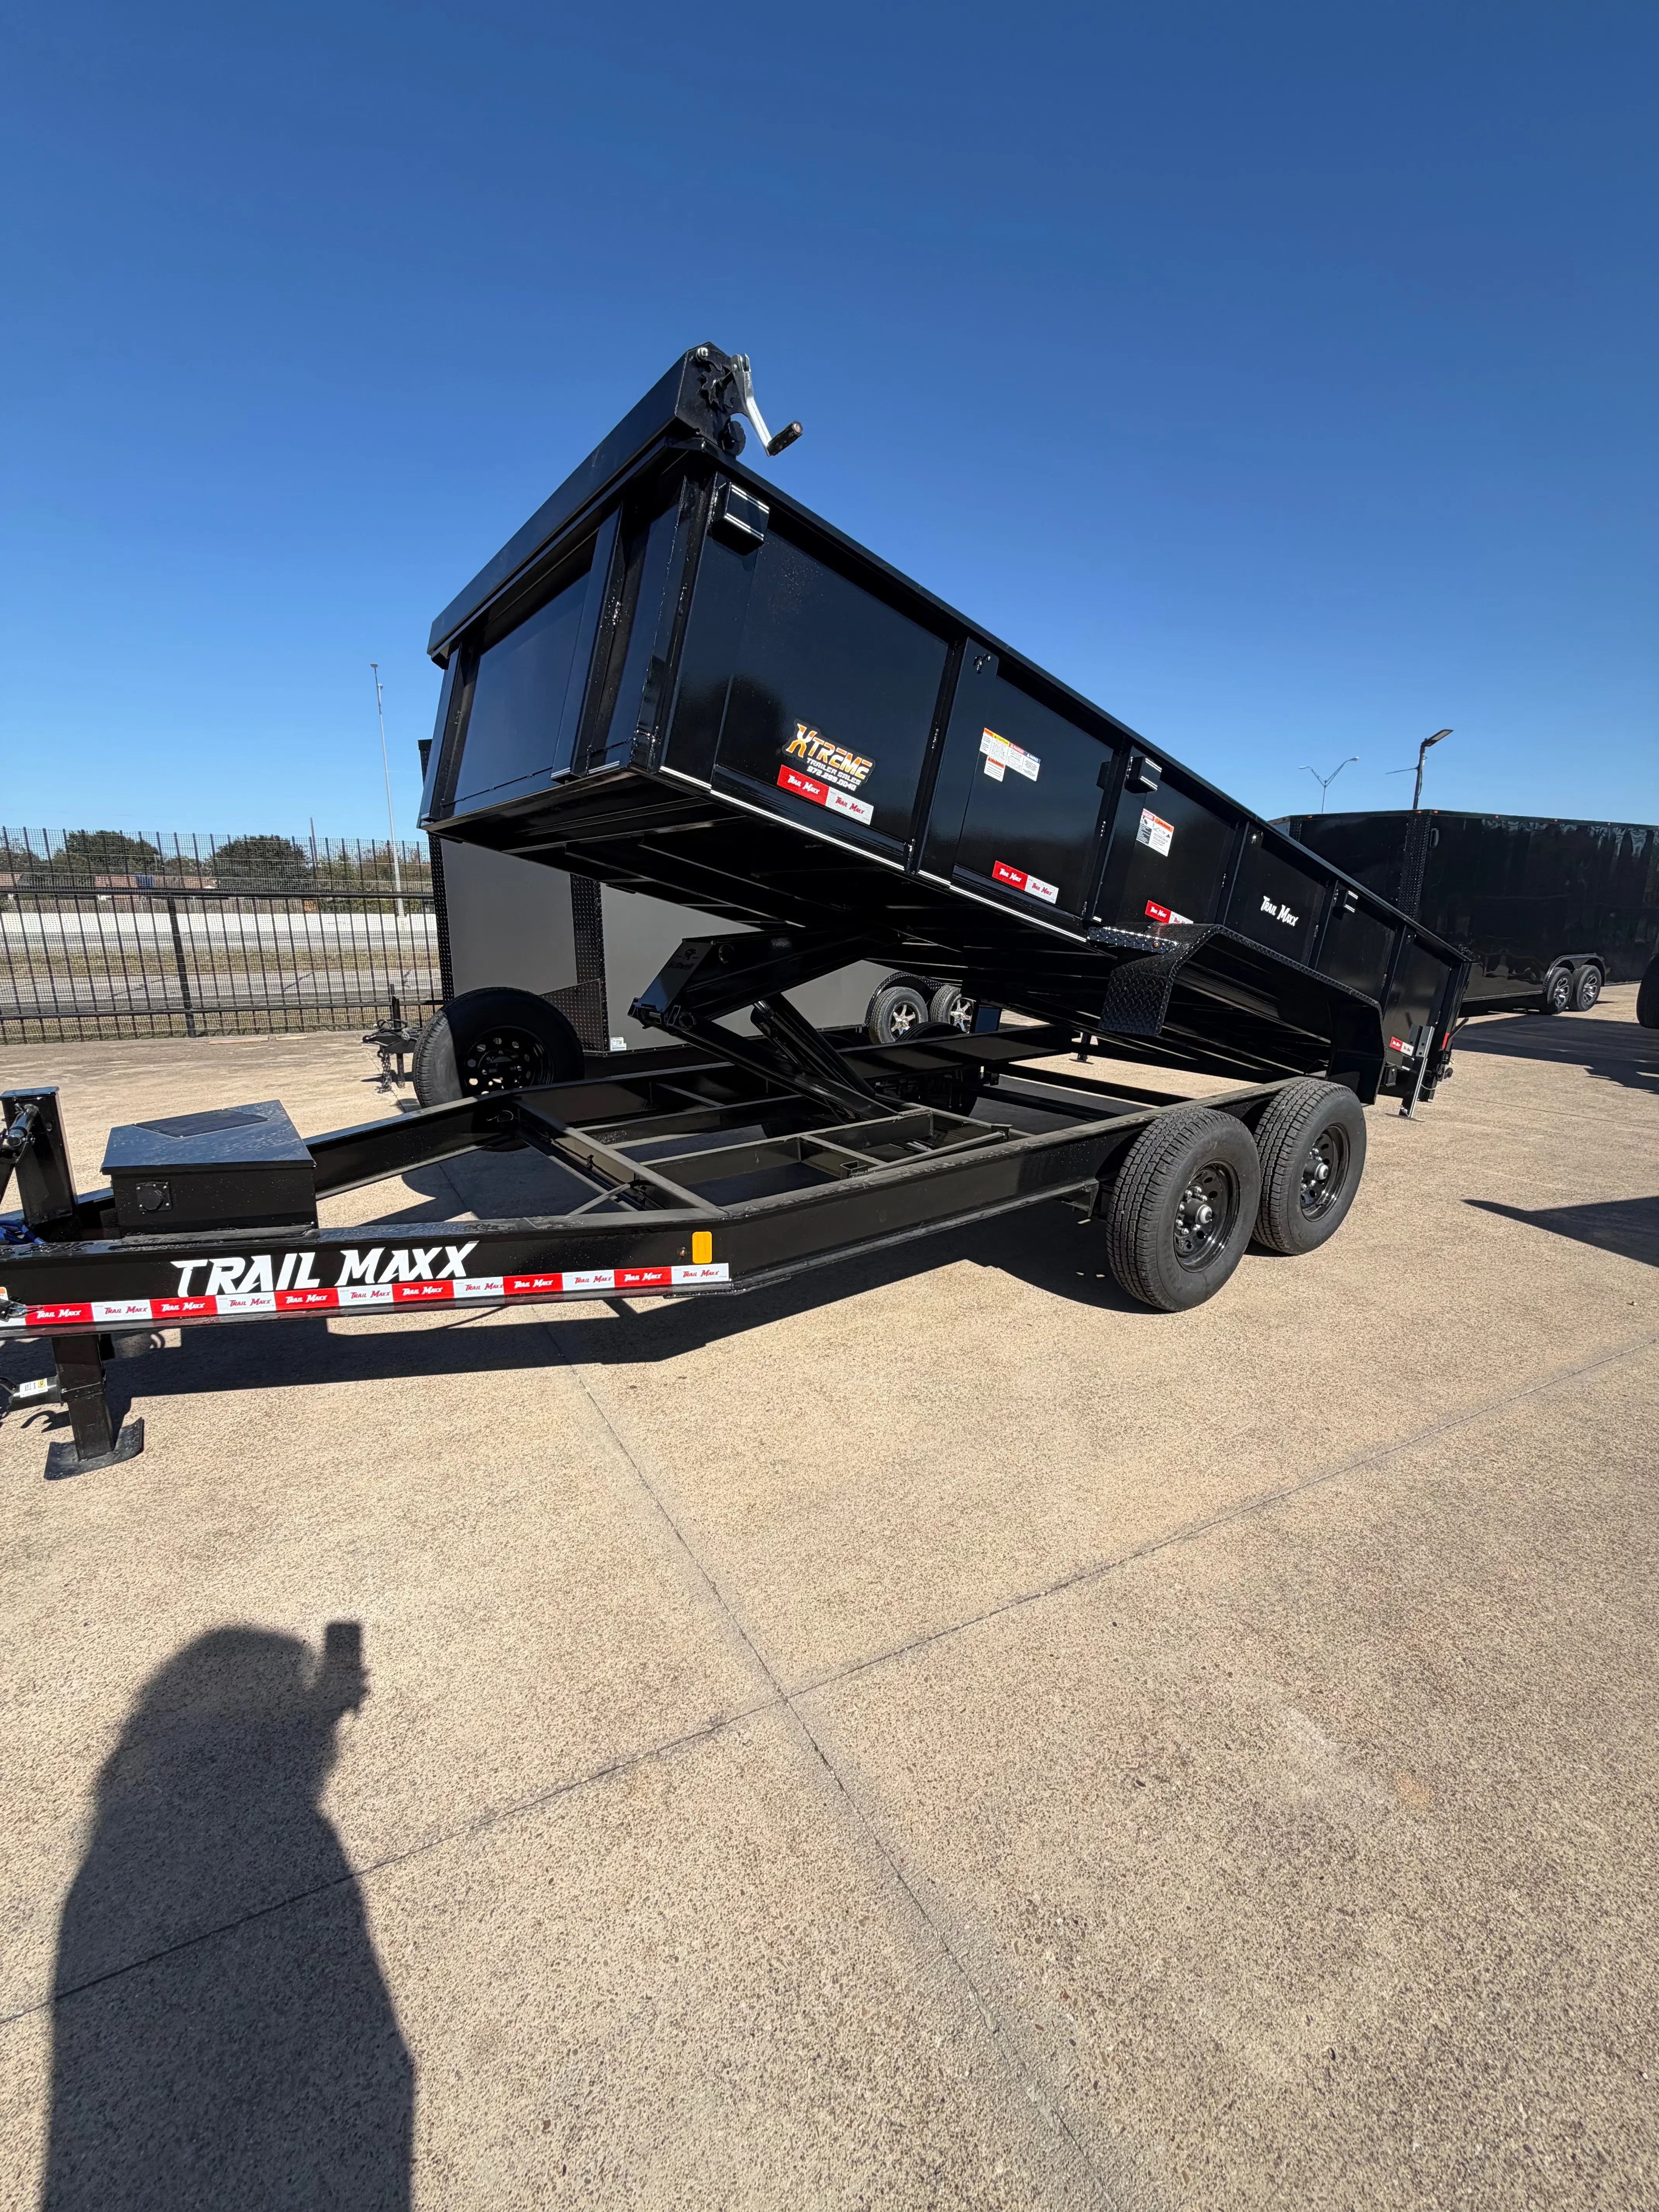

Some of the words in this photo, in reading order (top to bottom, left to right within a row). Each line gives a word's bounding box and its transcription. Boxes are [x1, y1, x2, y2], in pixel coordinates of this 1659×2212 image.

[786, 723, 873, 780] XTREME
[807, 757, 837, 775] TRAILER
[838, 771, 862, 786] SALES
[1261, 895, 1277, 915] TRAIL
[1276, 904, 1299, 926] MAXX
[170, 1252, 320, 1298] TRAIL
[334, 1240, 480, 1286] MAXX
[624, 1274, 640, 1282] TRAIL
[641, 1272, 663, 1281] MAXX
[484, 1282, 503, 1290] MAXX
[514, 1280, 530, 1289] TRAIL
[532, 1279, 553, 1288] MAXX
[421, 1286, 443, 1295] MAXX
[285, 1296, 303, 1304] TRAIL
[306, 1294, 328, 1303] MAXX
[125, 1306, 148, 1314] MAXX
[161, 1304, 180, 1312] TRAIL
[182, 1302, 205, 1310] MAXX
[36, 1311, 55, 1319] TRAIL
[58, 1309, 81, 1318] MAXX
